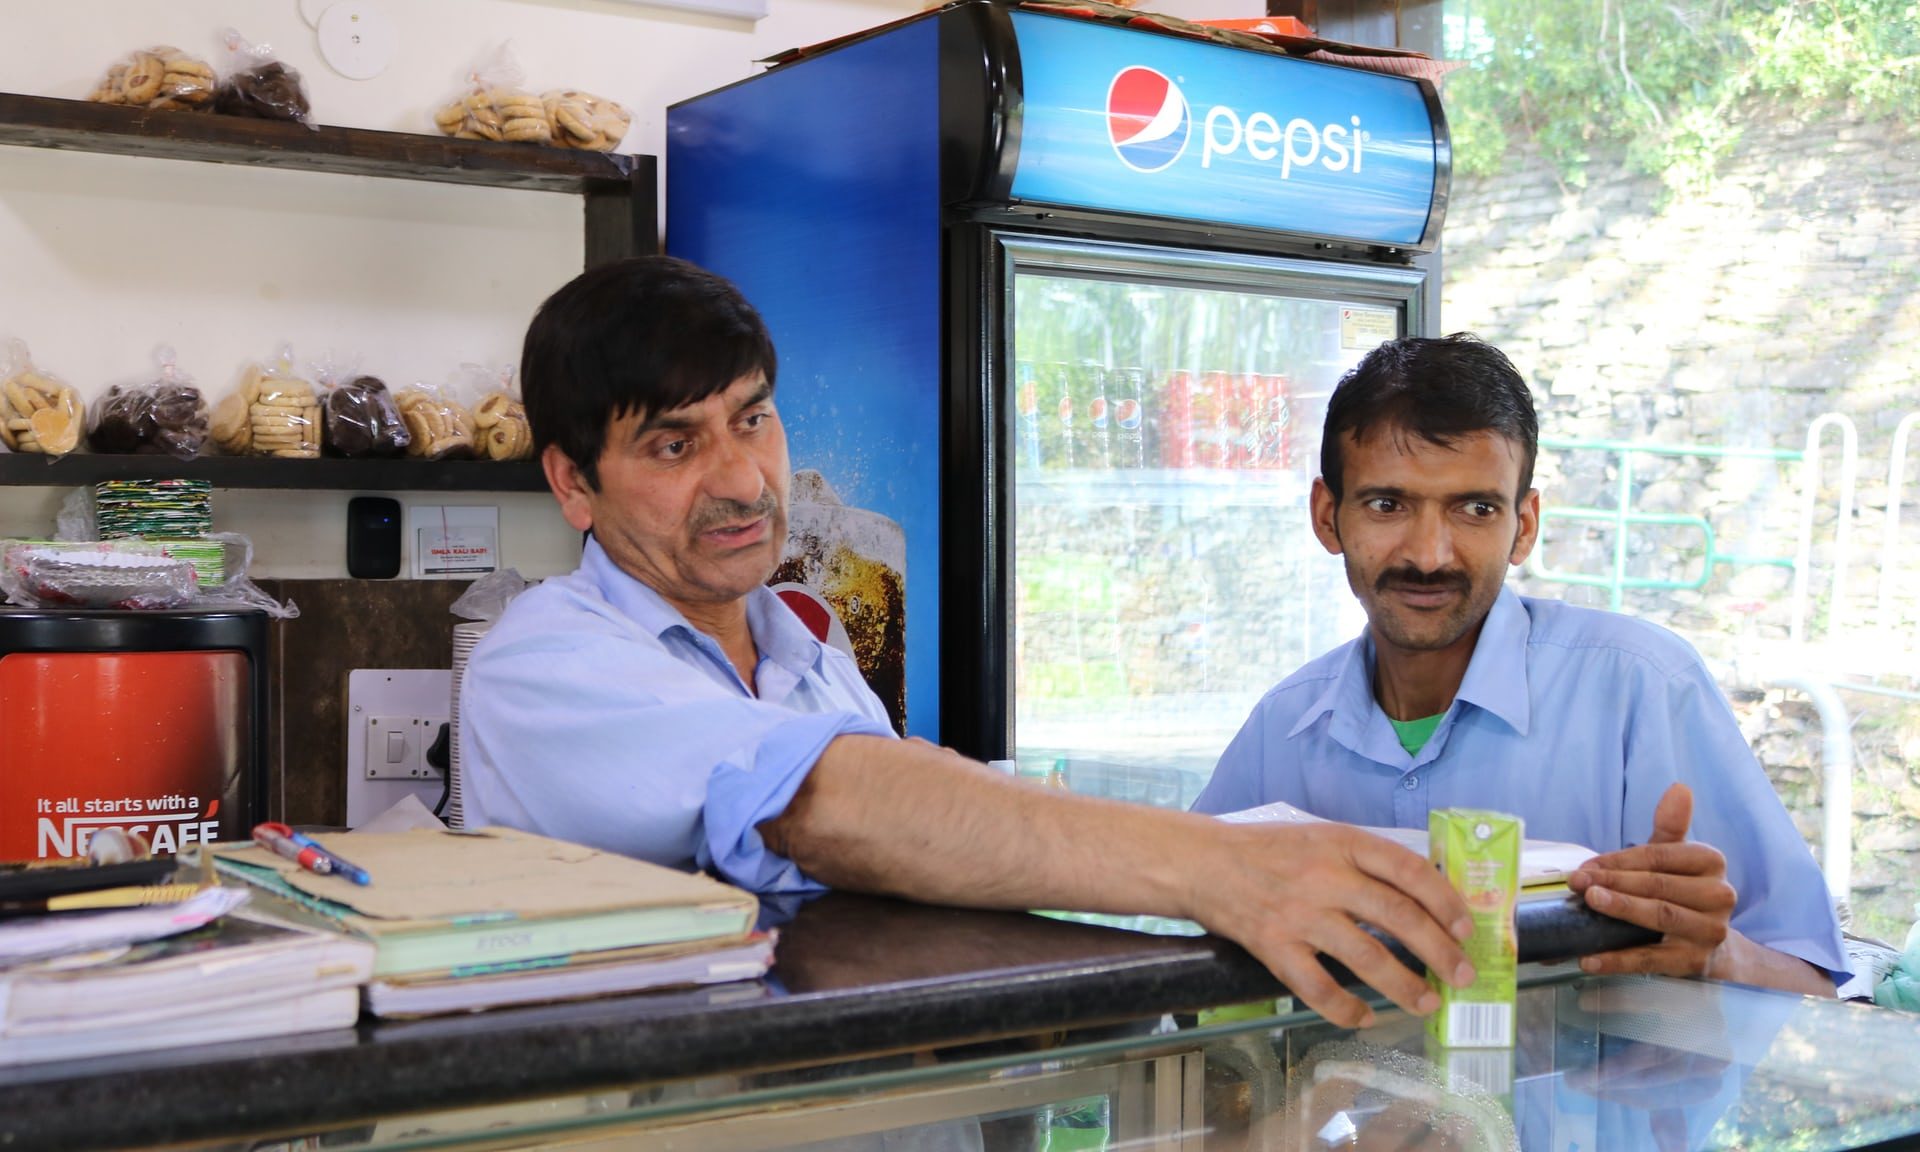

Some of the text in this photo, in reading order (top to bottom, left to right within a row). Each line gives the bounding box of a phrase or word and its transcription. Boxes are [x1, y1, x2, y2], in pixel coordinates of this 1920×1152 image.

[1201, 105, 1361, 179] pepsi
[38, 794, 199, 813] It all starts with a
